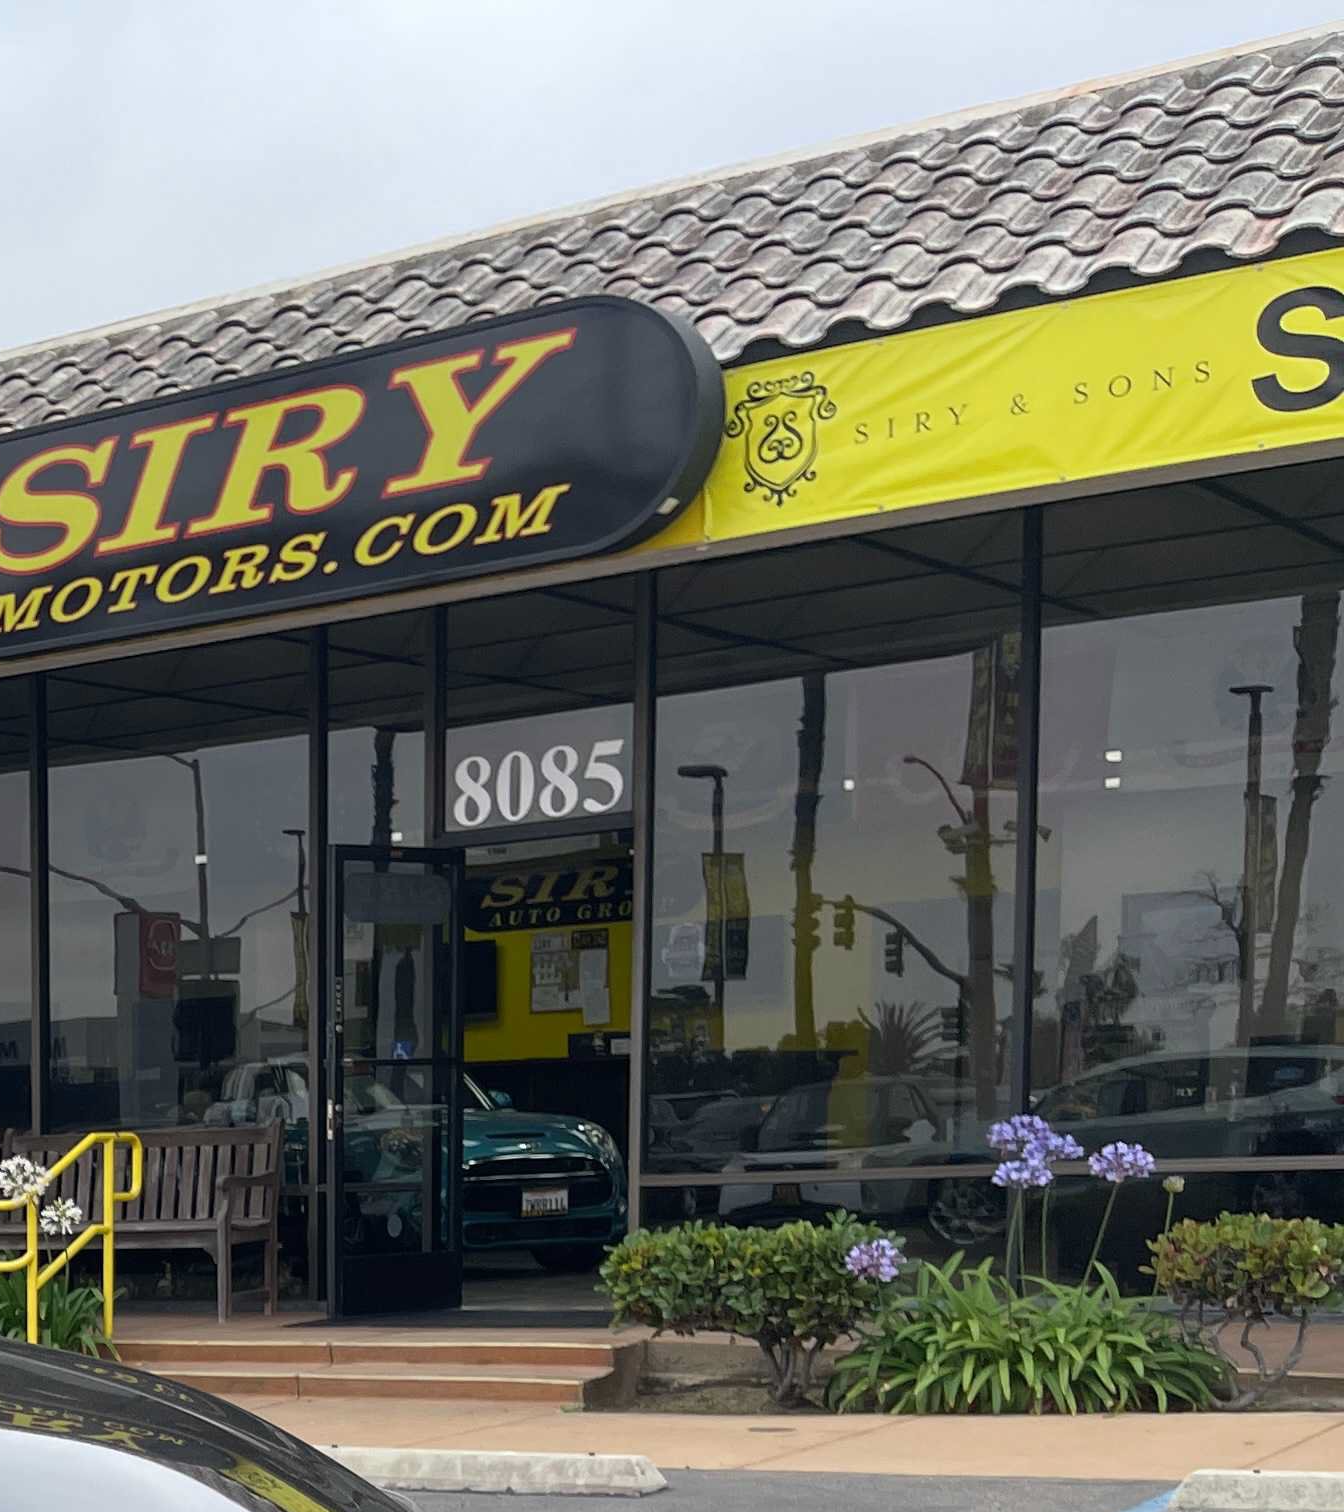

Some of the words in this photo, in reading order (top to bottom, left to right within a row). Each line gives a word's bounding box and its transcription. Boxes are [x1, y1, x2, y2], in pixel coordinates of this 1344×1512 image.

[854, 404, 968, 446] SIRY
[1010, 393, 1030, 416] &
[1073, 361, 1213, 405] SONS
[453, 738, 625, 827] 8085
[479, 864, 632, 910] SIR
[487, 906, 561, 928] AUTO
